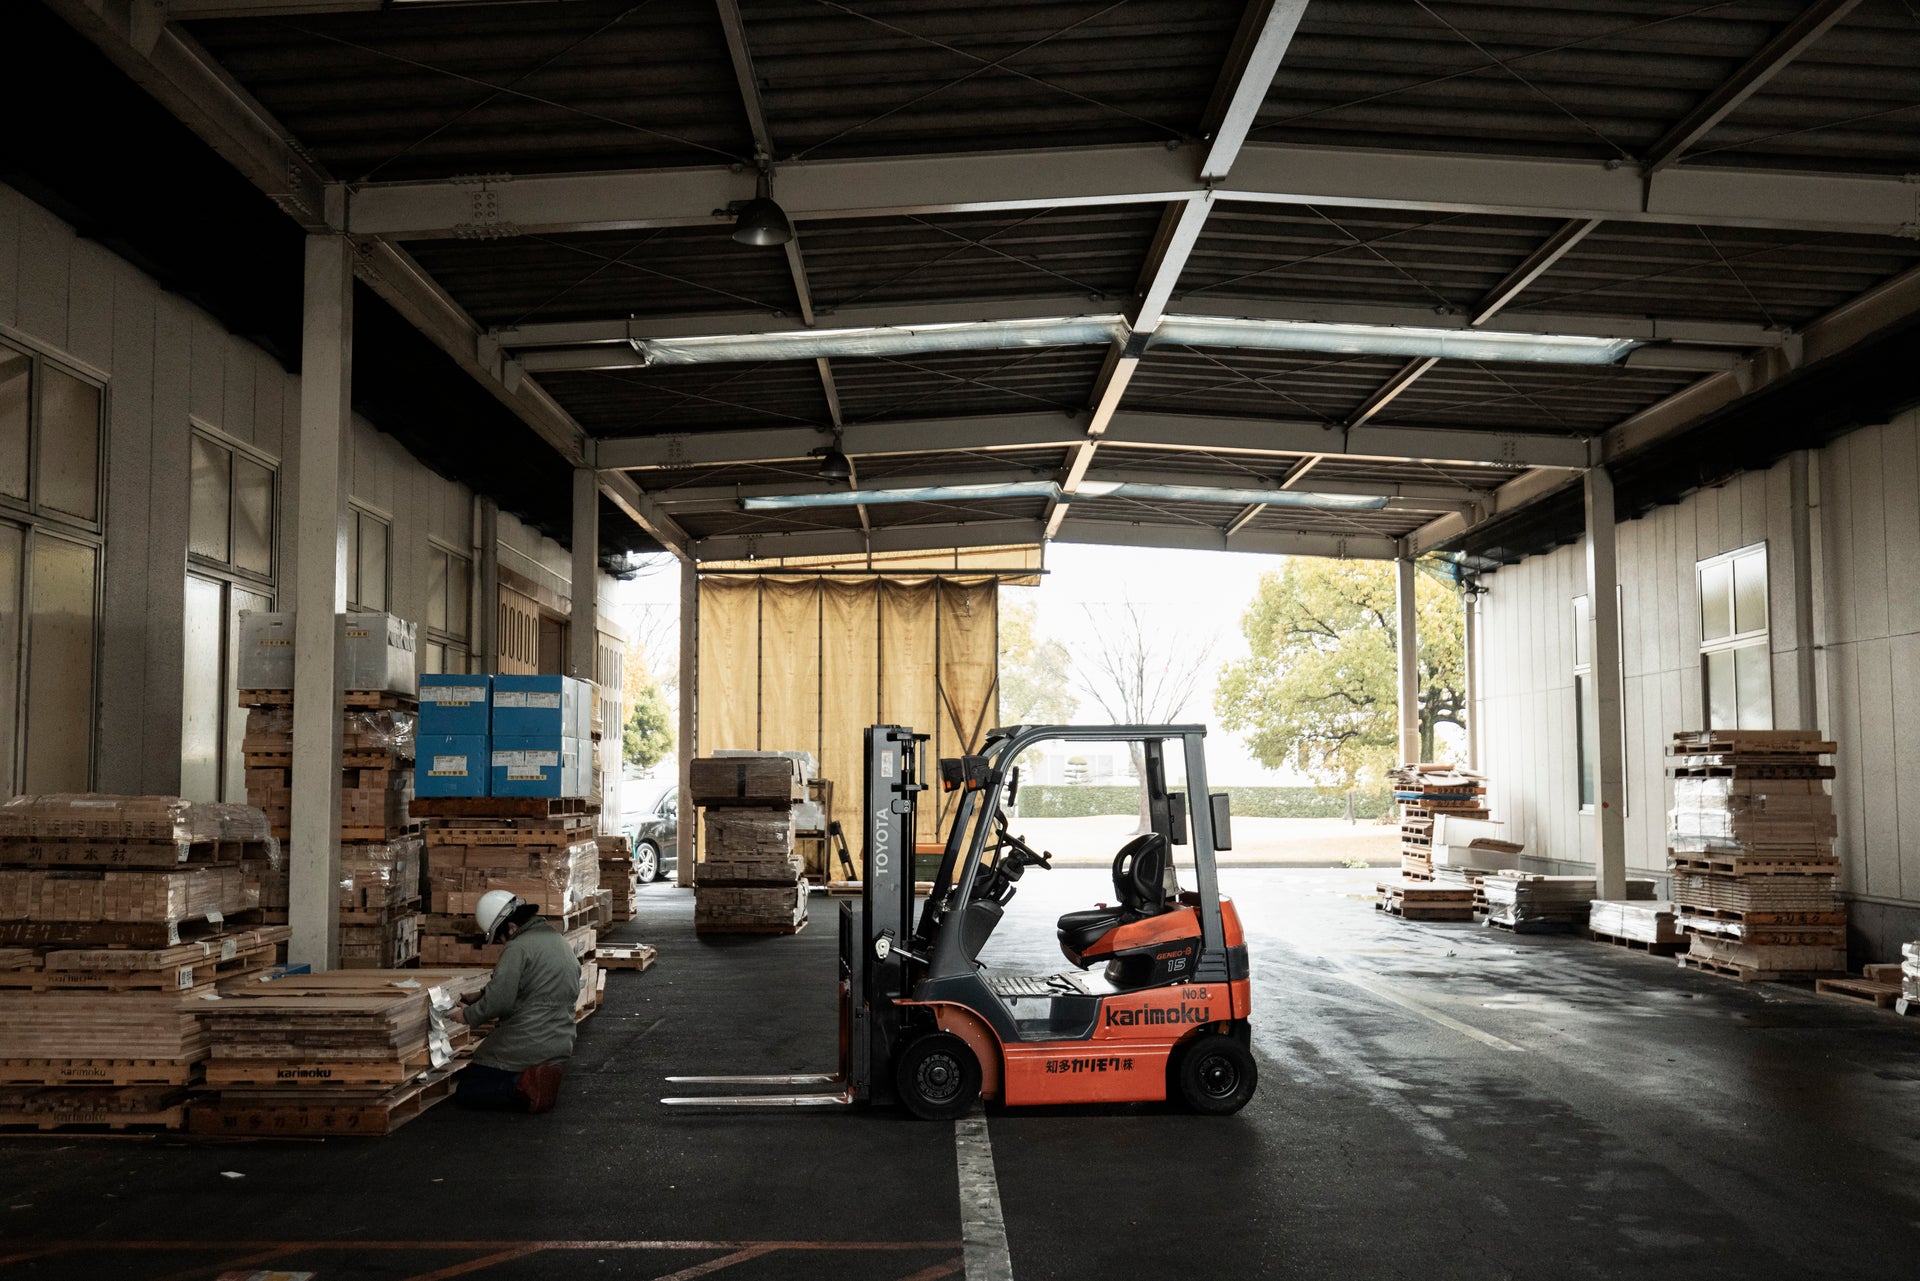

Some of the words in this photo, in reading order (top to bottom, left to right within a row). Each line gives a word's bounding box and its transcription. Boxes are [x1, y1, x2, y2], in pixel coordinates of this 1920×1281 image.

[875, 807, 889, 877] TOYOTA
[1167, 957, 1187, 972] 15
[1182, 987, 1207, 1000] No.8
[1106, 1002, 1210, 1027] karimoku
[60, 1067, 107, 1077] karimoku
[277, 1067, 332, 1079] karimoku
